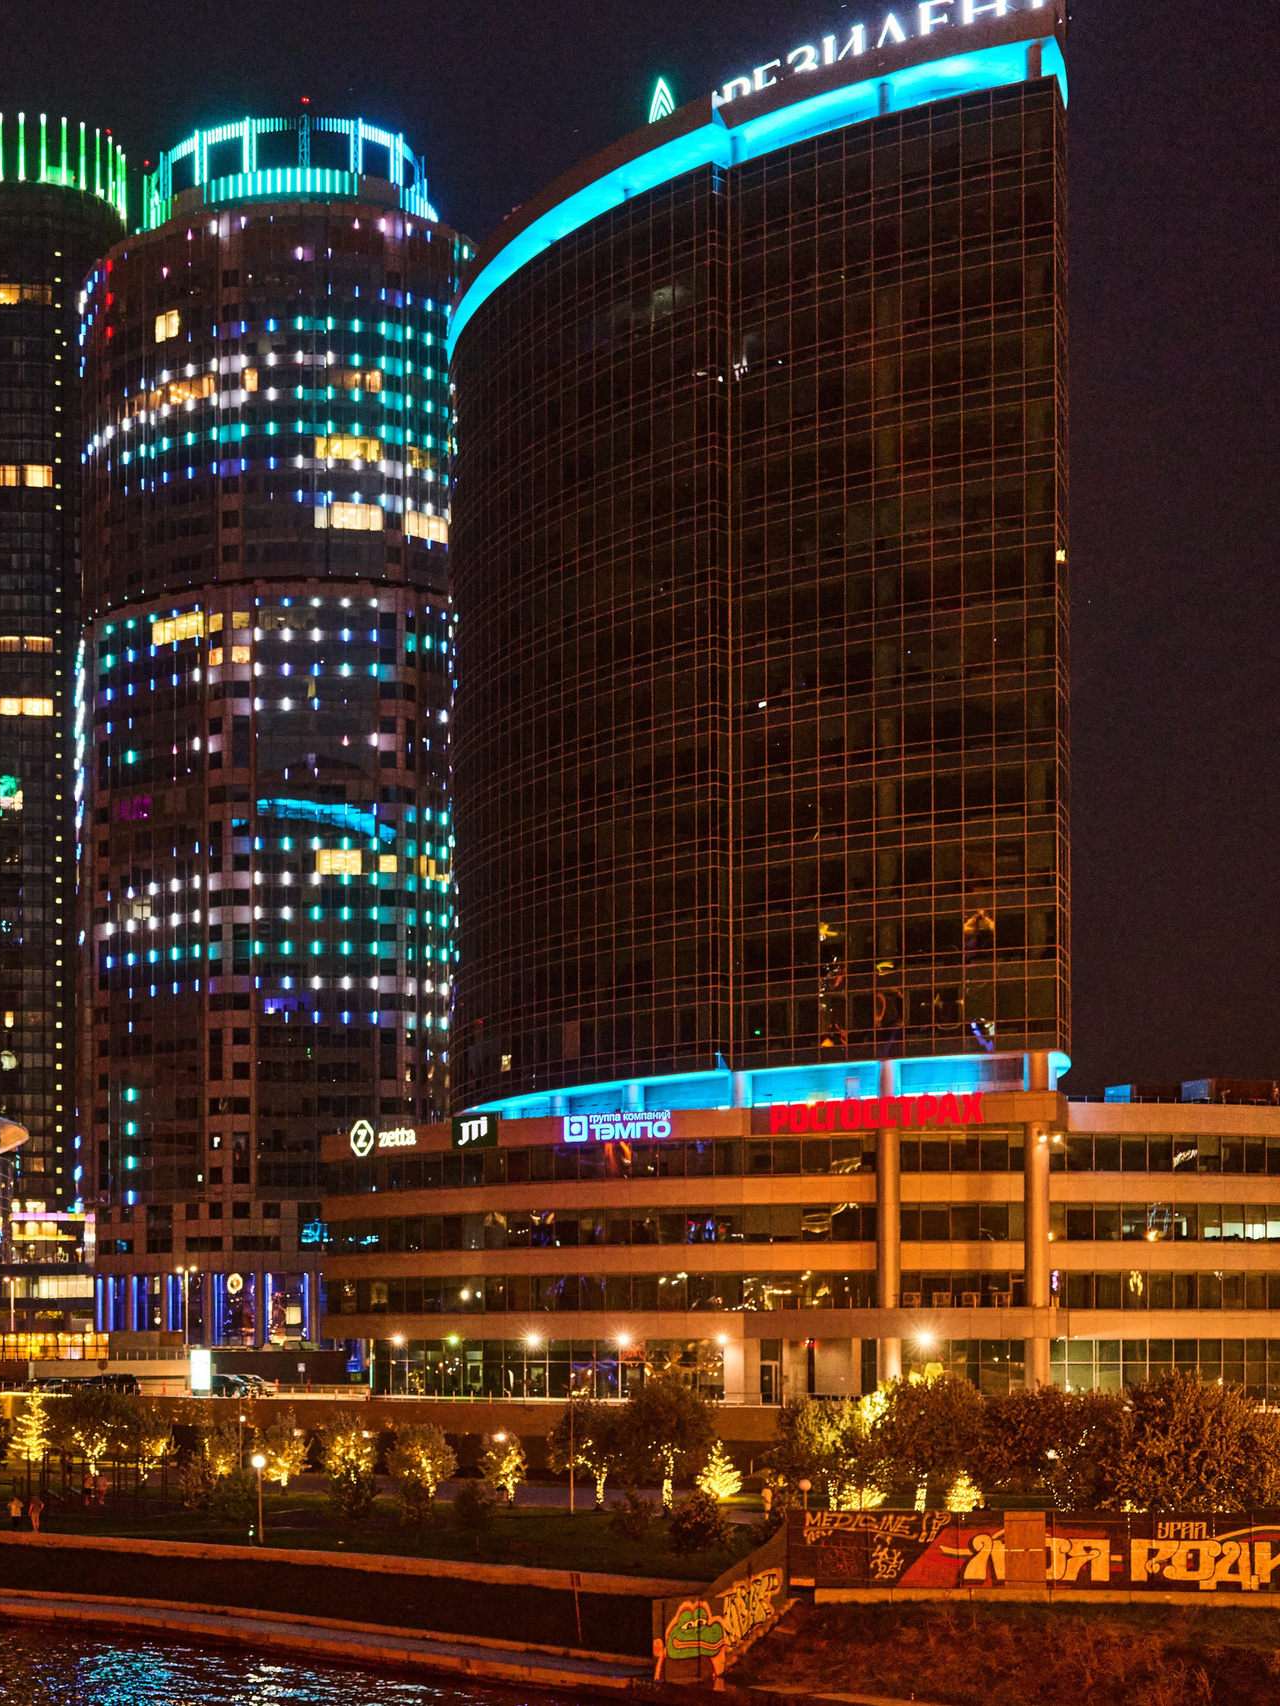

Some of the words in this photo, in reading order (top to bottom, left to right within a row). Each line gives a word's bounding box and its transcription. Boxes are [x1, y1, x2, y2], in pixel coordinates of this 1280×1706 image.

[589, 1112, 621, 1125] группа
[623, 1109, 671, 1122] компаний
[770, 1091, 984, 1134] РОСГОССТРАХ
[378, 1126, 417, 1148] zetta
